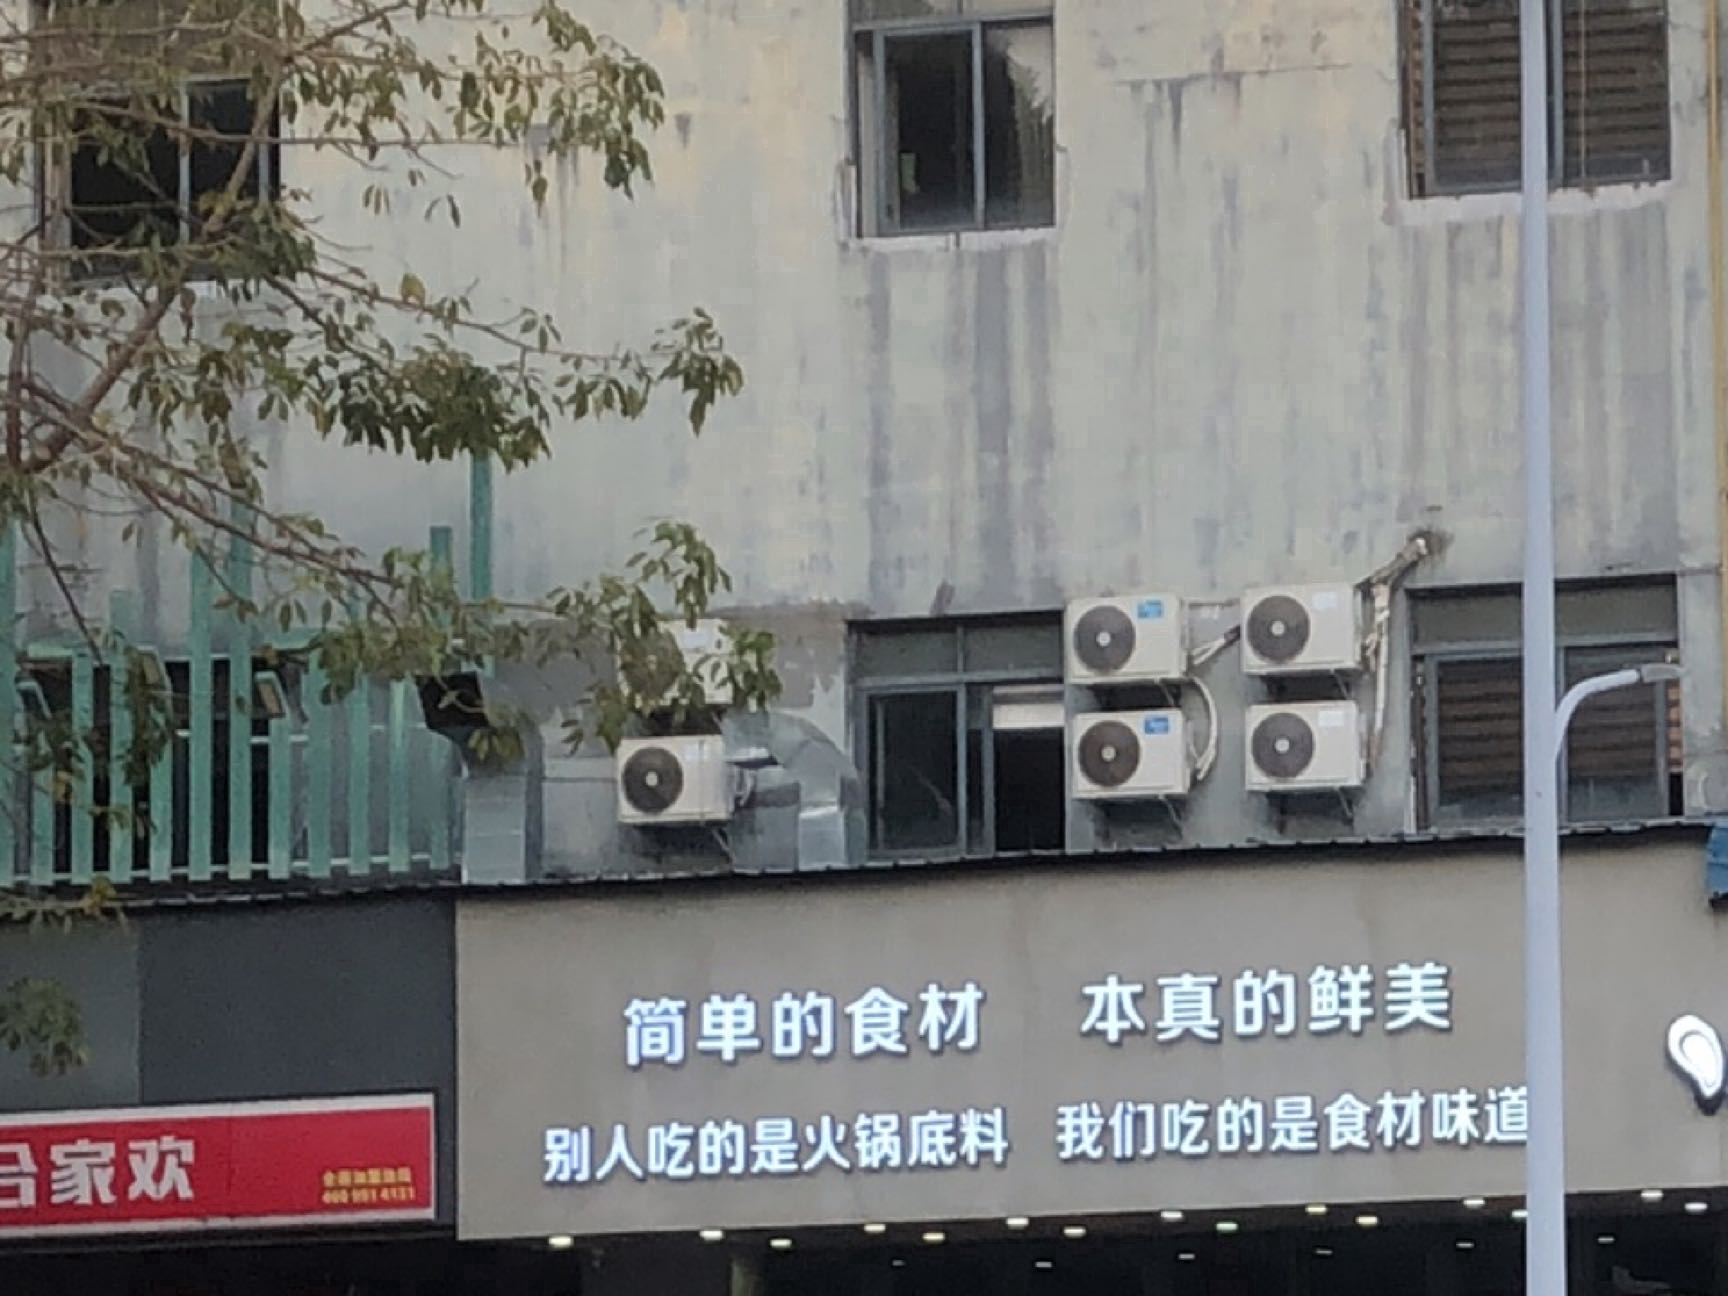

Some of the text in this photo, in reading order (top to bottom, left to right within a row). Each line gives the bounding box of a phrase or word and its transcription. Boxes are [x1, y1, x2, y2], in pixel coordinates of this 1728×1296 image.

[623, 961, 1453, 1067] 简单的食材 本真的鲜美
[542, 1085, 1527, 1184] 别人吃的是火锅底料 我们吃的是食材味道
